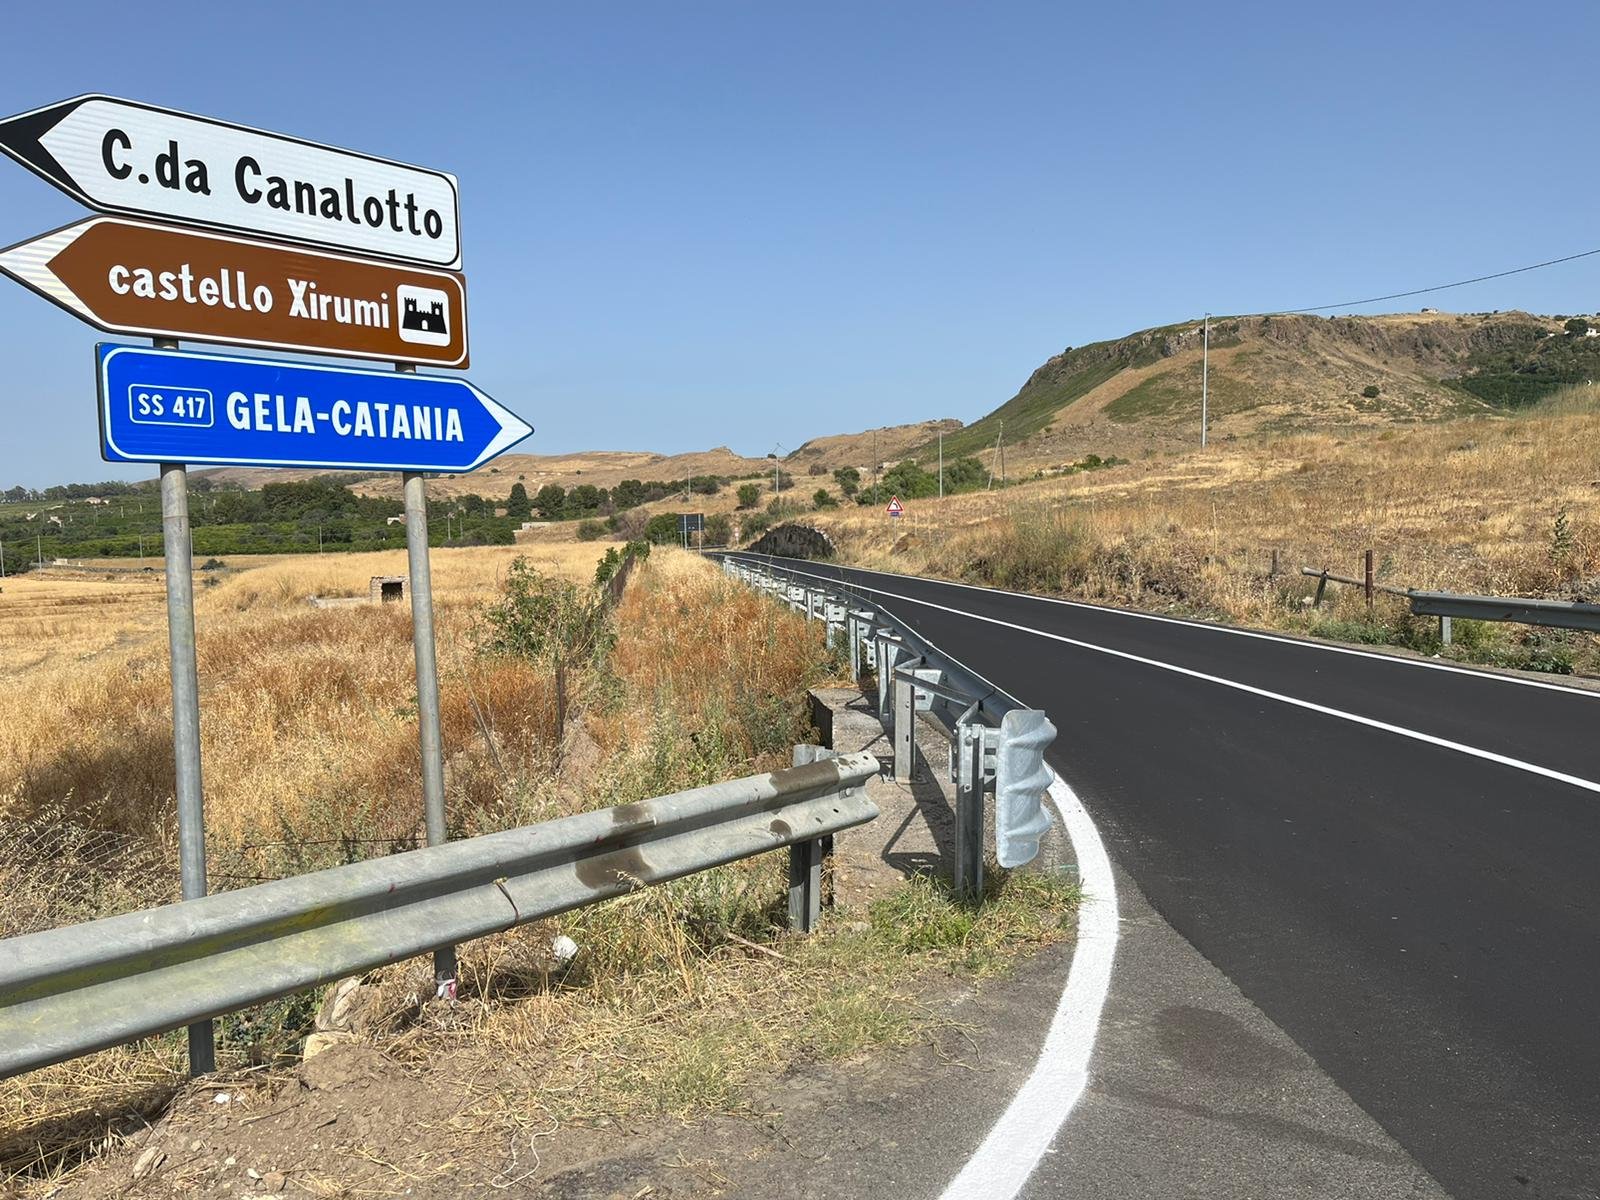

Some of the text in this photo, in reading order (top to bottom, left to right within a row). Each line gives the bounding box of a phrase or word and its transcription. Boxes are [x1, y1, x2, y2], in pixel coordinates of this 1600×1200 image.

[101, 128, 443, 239] C.da Canalotto
[107, 263, 390, 328] castello Xirumi
[138, 391, 464, 442] SS 417 GELA-CATANIA
